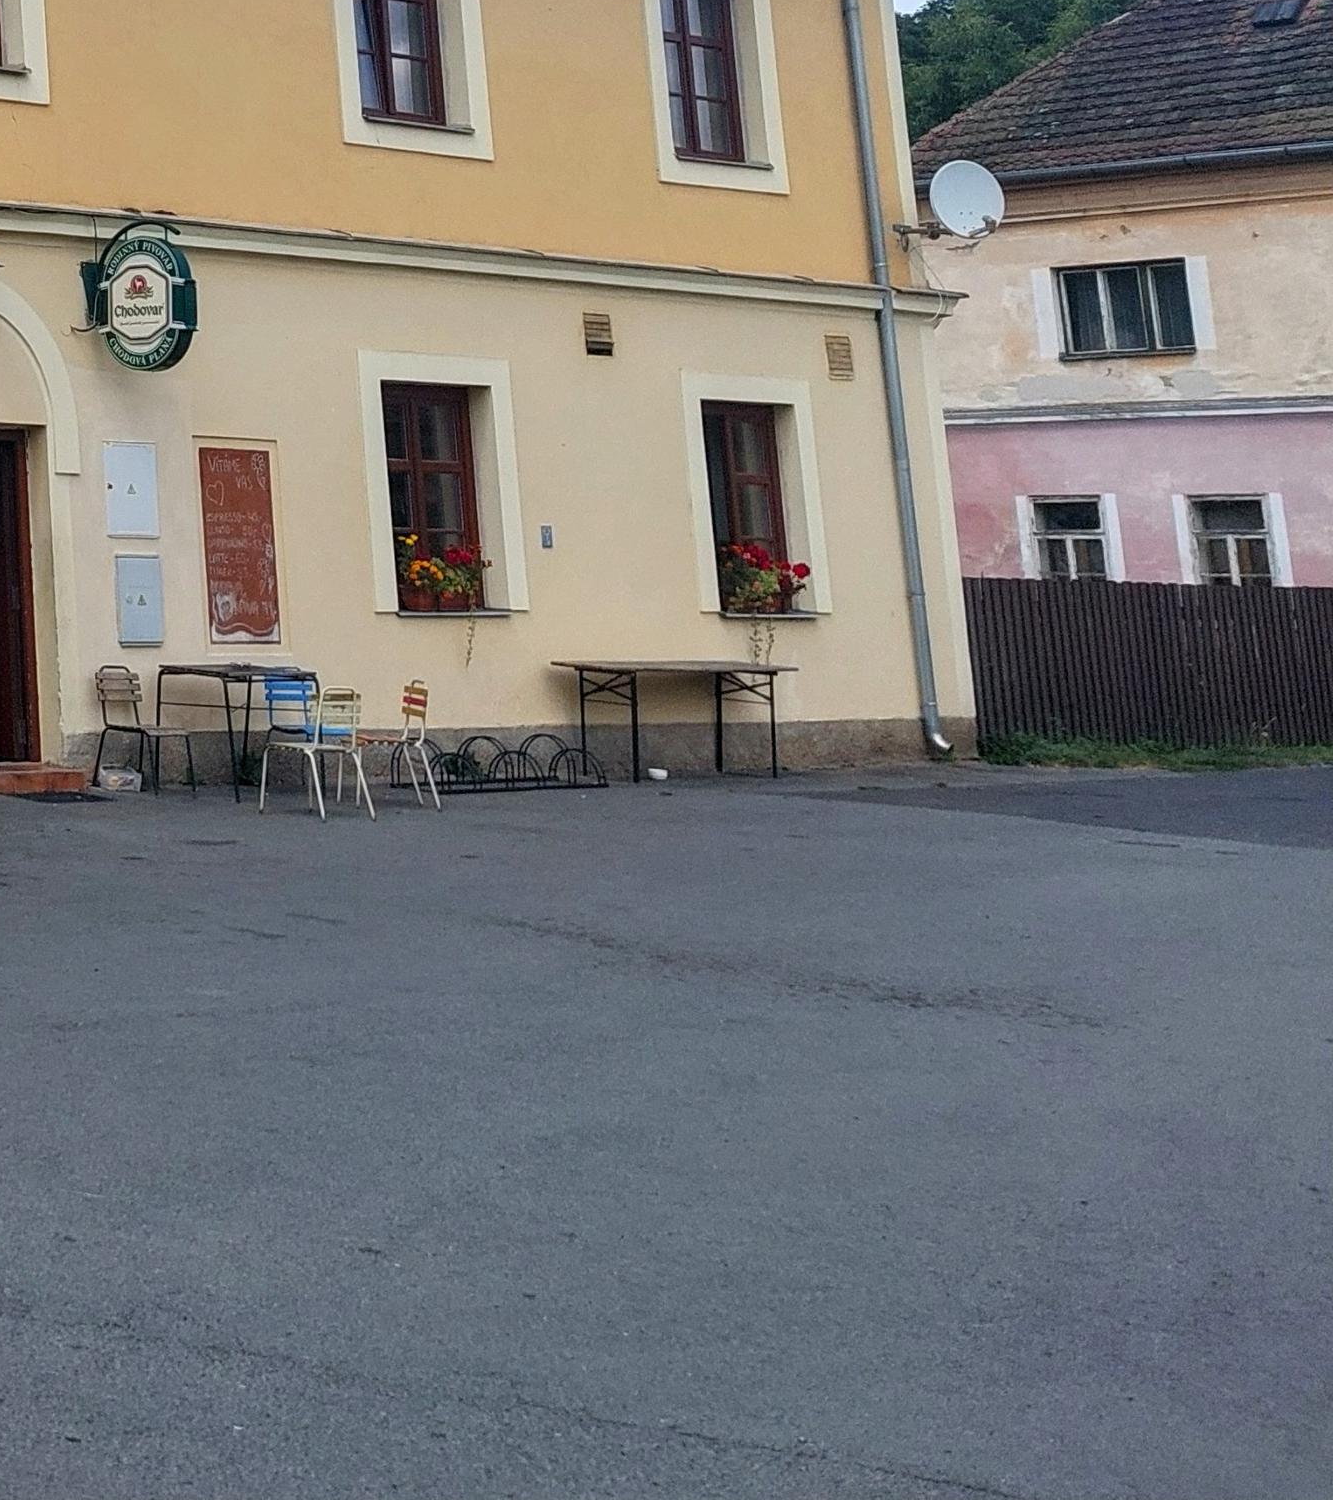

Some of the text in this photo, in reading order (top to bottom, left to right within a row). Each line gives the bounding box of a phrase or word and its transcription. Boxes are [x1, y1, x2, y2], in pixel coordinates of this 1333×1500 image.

[107, 240, 173, 275] RODINNÝ PIVOVAR
[114, 303, 164, 318] Chodovar
